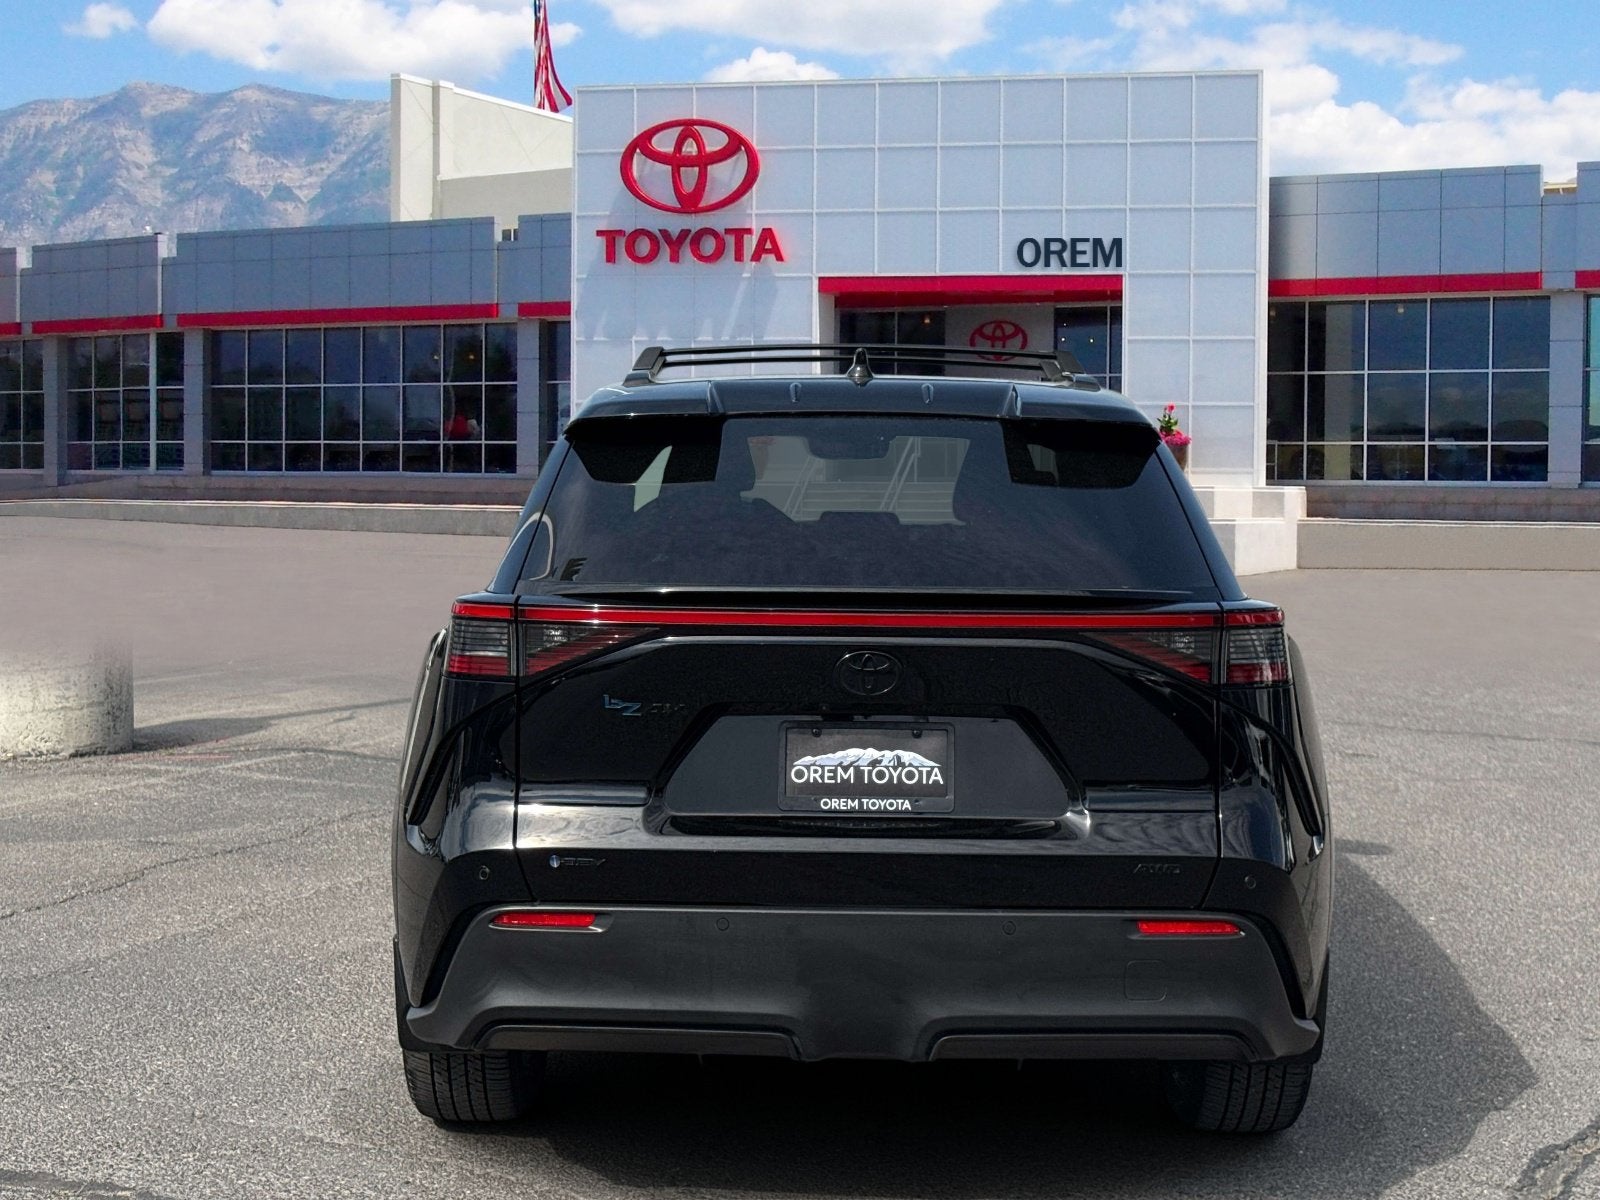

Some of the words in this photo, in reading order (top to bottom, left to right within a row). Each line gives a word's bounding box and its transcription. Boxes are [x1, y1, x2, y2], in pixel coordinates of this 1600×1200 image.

[596, 227, 784, 264] TOYOTA
[1017, 237, 1123, 268] OREM
[790, 765, 854, 784] OREM
[860, 766, 944, 785] TOYOTA
[820, 798, 858, 810] OREM
[861, 799, 912, 811] TOYOTA
